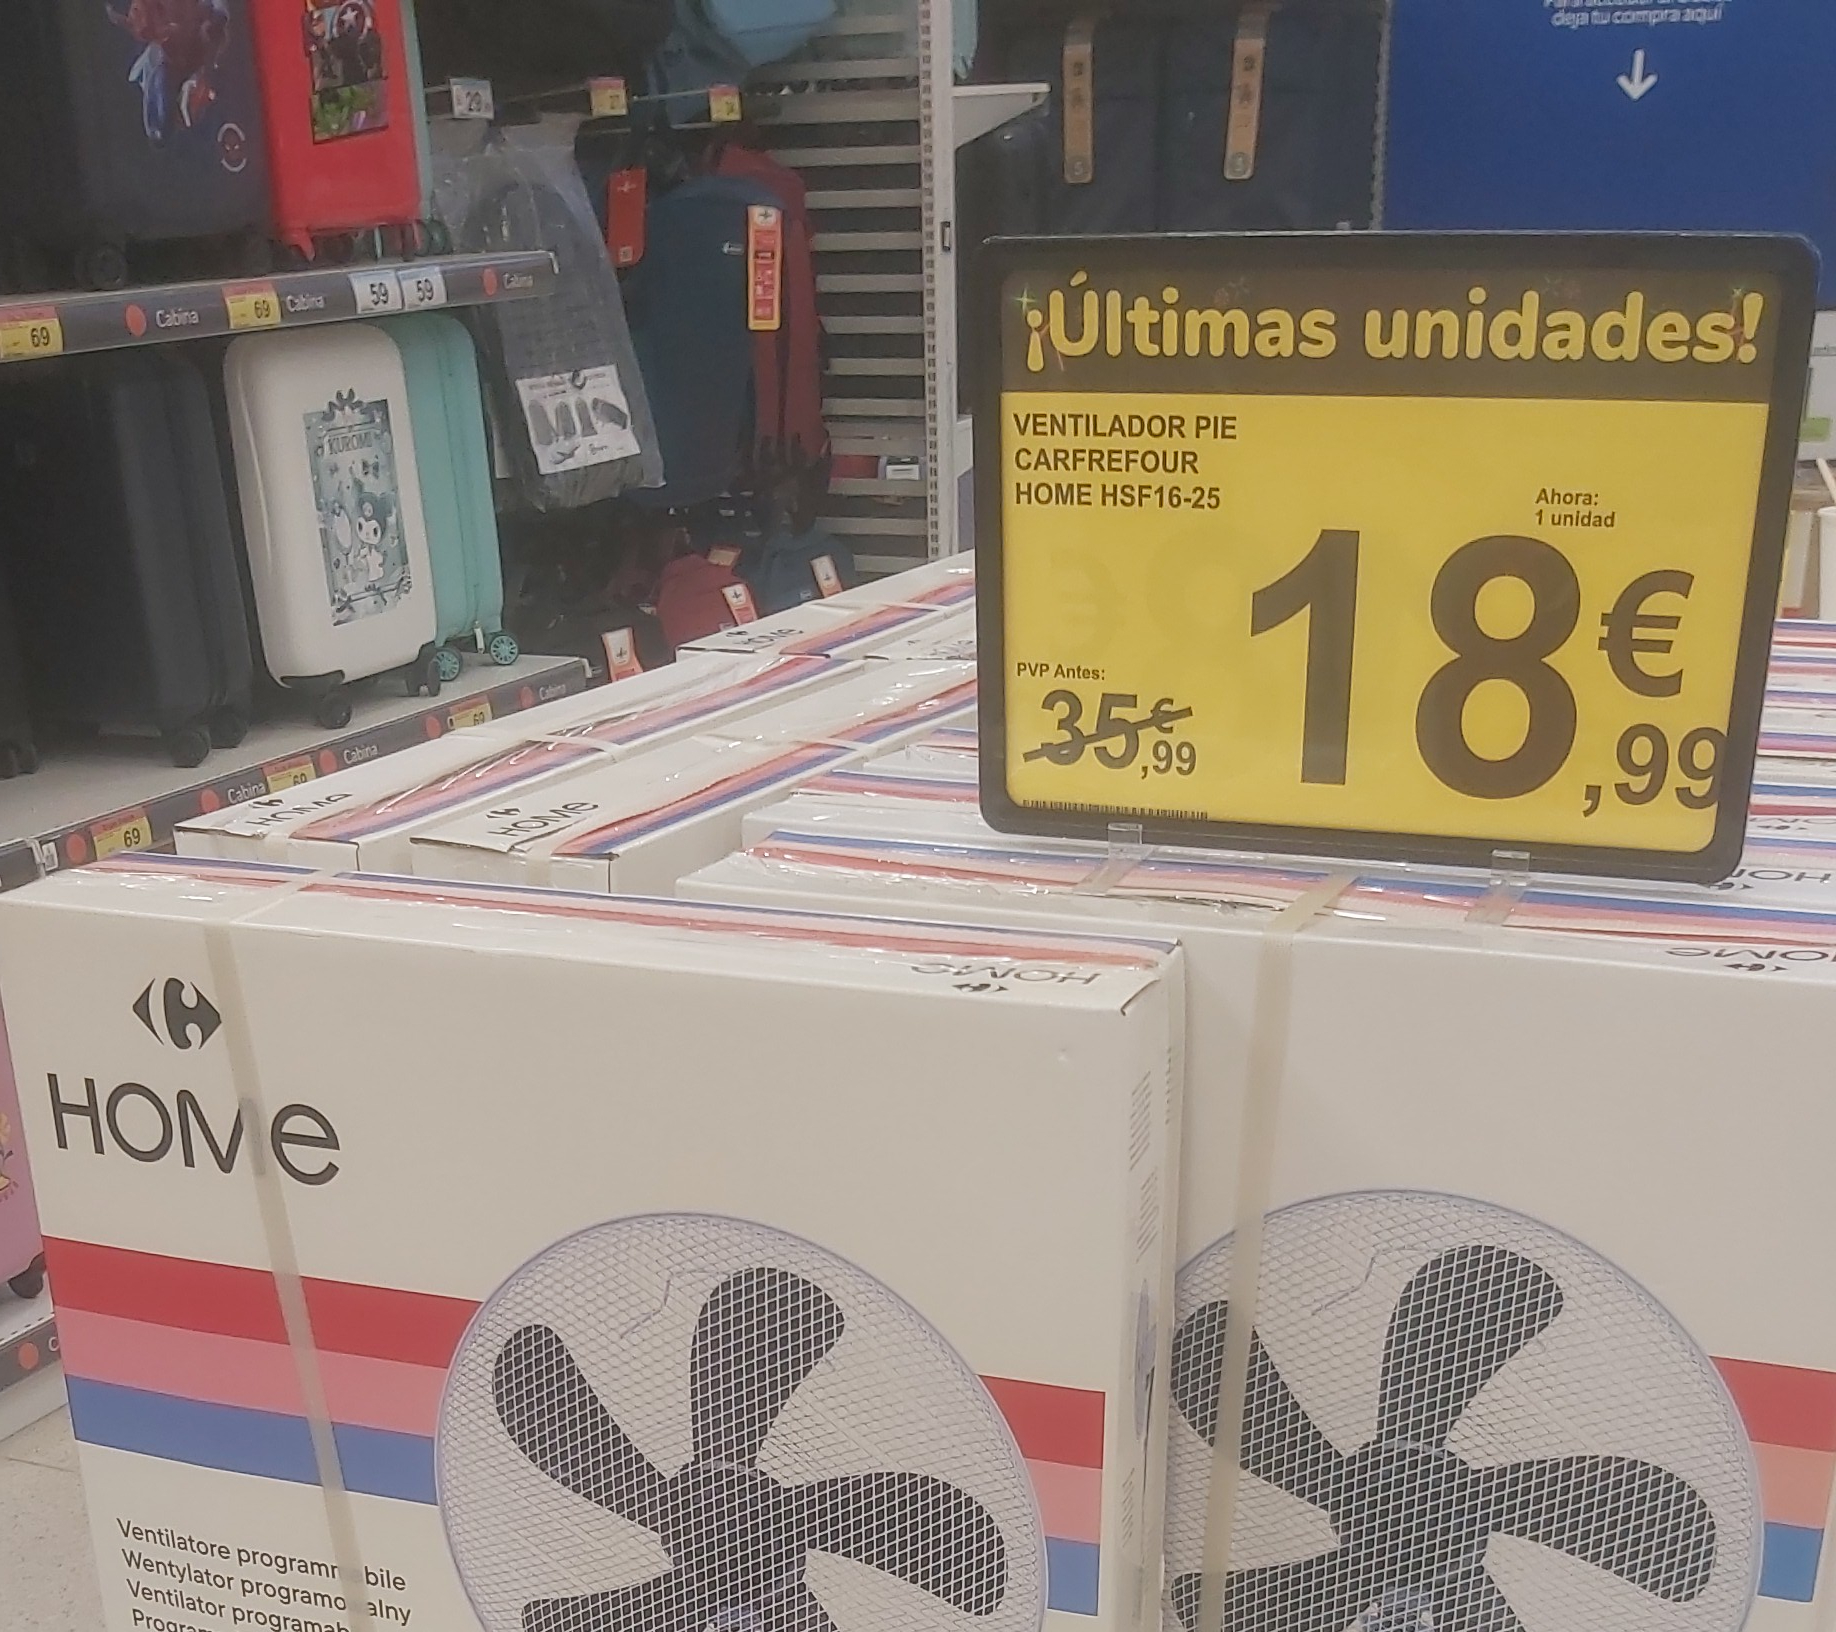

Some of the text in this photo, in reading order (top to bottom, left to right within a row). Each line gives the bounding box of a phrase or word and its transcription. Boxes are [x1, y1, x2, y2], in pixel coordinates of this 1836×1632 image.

[369, 282, 389, 306] 59
[416, 278, 434, 302] 59
[155, 308, 200, 330] Cabina
[254, 299, 271, 319] 69
[1026, 270, 1763, 373] ¡Últimas unidades!
[31, 326, 51, 348] 69
[1013, 413, 1237, 440] VENTILADOR PIE
[1014, 447, 1199, 474] CARFREFOUR
[1015, 482, 1220, 510] HOME HSF16-25
[1535, 487, 1599, 507] Ahora:
[1534, 508, 1616, 528] 1 unidad
[1016, 662, 1106, 681] PVP Antes:
[343, 744, 379, 764] Cabina
[227, 780, 266, 805] Cabina
[123, 827, 141, 848] 69
[116, 1517, 232, 1560] Ventilatore
[121, 1548, 235, 1590] Wentylator
[126, 1578, 226, 1619] Ventilator
